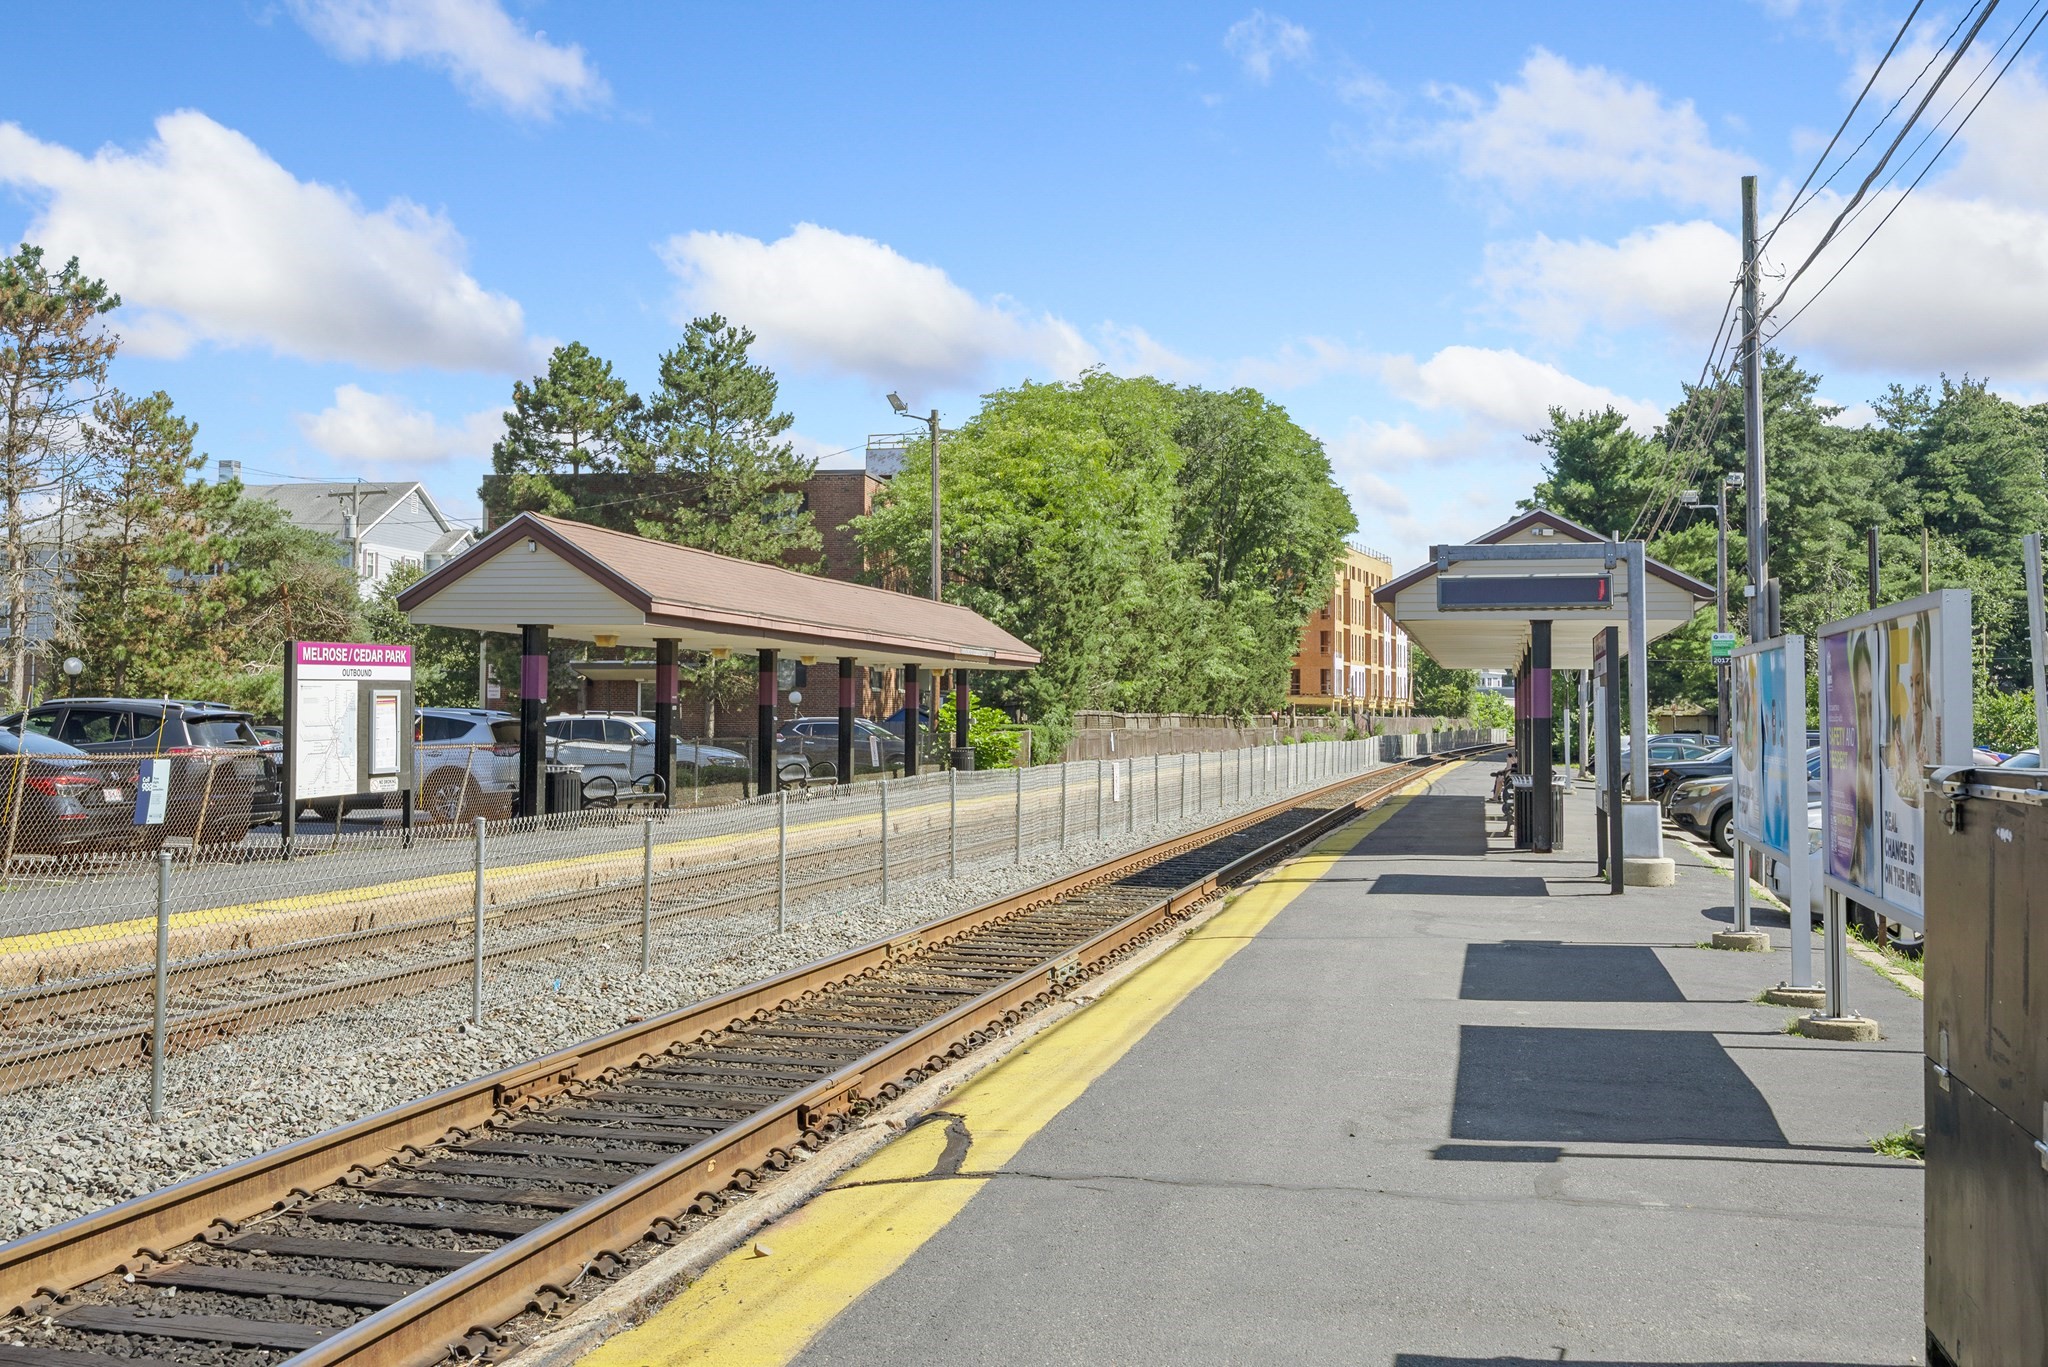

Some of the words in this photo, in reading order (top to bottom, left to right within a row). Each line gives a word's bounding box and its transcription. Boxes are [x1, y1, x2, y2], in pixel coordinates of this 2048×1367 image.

[385, 650, 407, 663] PARK
[342, 669, 372, 677] OUTBOUND
[1829, 727, 1845, 746] SAFETY
[1846, 727, 1855, 747] AND
[1884, 810, 1898, 833] REAL
[1885, 837, 1908, 863] CHANGE
[1908, 844, 1915, 866] IS
[1884, 863, 1893, 885] ON
[1894, 866, 1905, 890] THE
[1905, 871, 1921, 897] MENU
